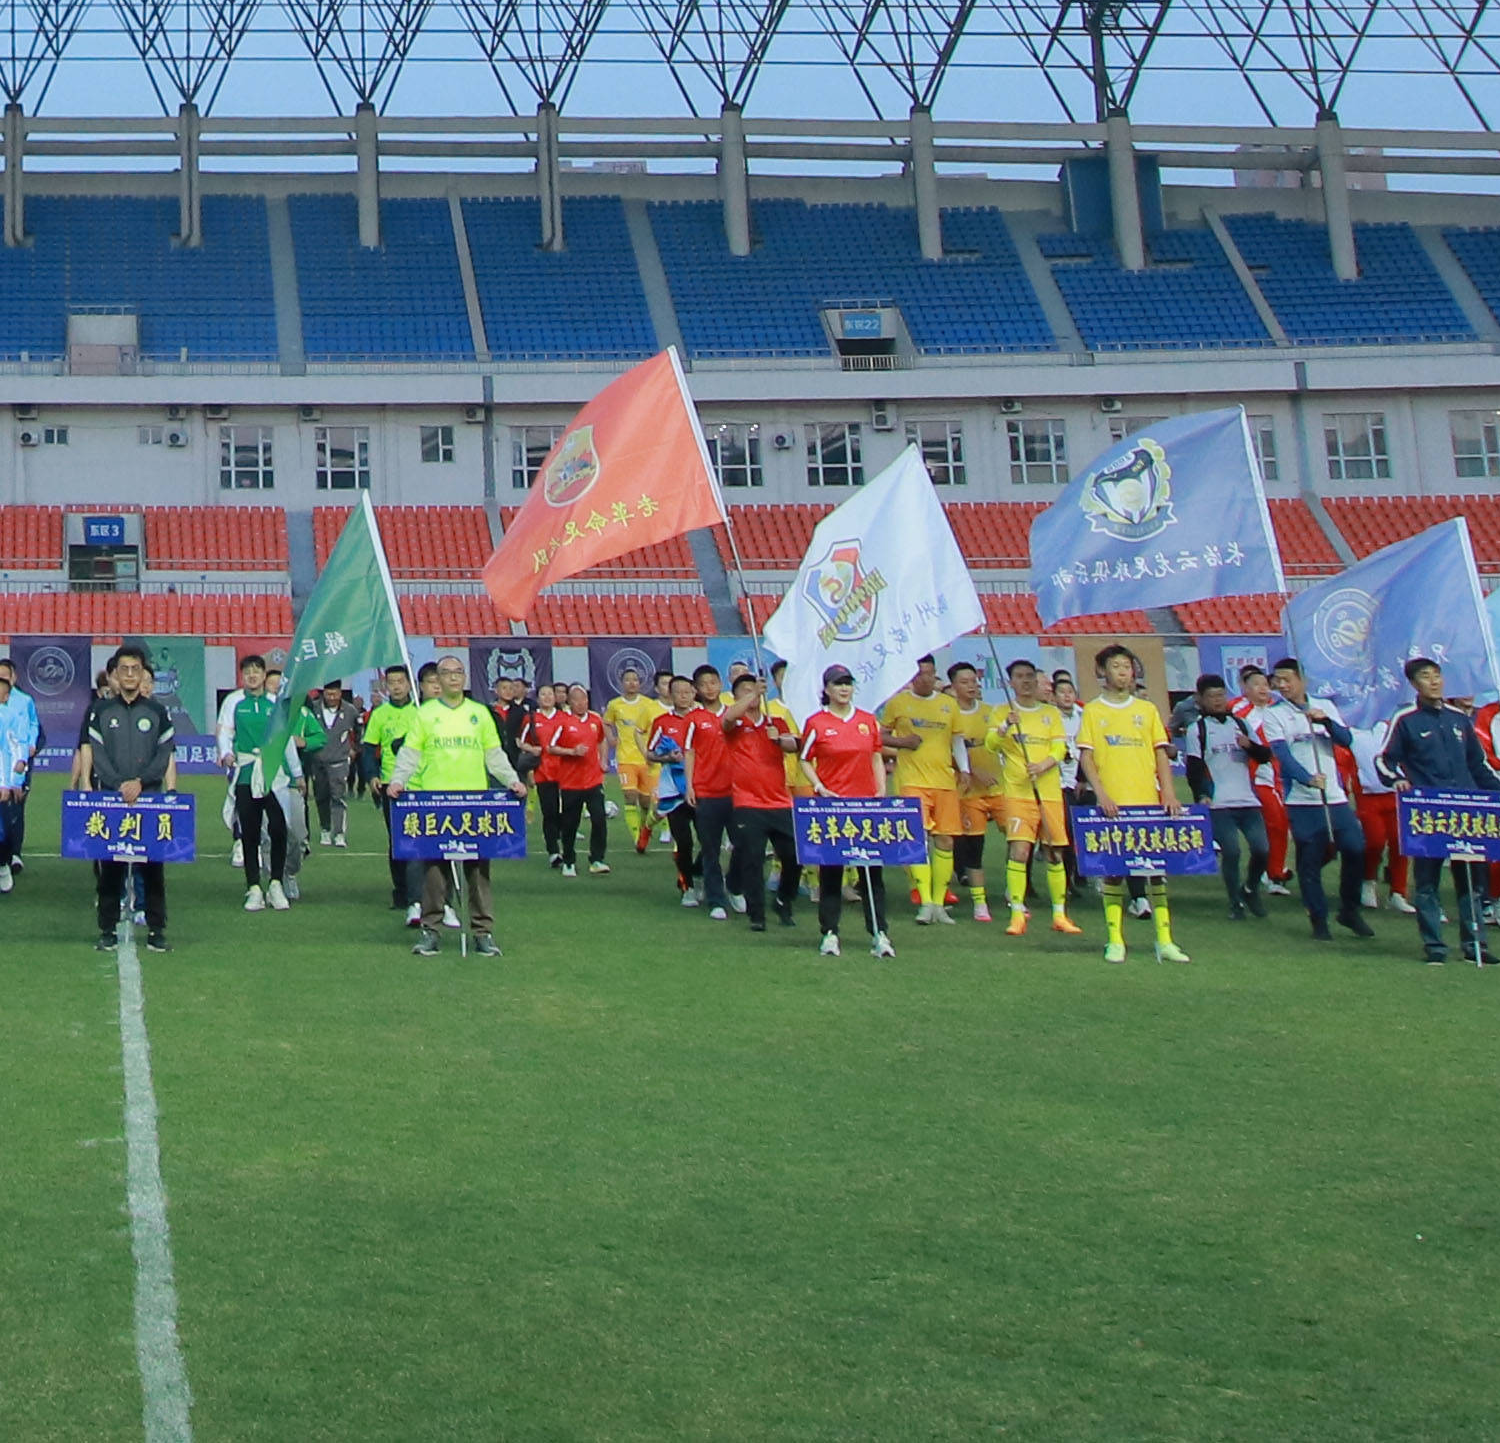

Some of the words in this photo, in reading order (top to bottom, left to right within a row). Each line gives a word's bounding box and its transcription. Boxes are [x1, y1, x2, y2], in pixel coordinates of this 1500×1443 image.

[90, 524, 120, 537] 东区3
[85, 810, 174, 840] 裁判员
[403, 810, 516, 839] 绿巨人足球队
[806, 815, 916, 846] 老革命足球队
